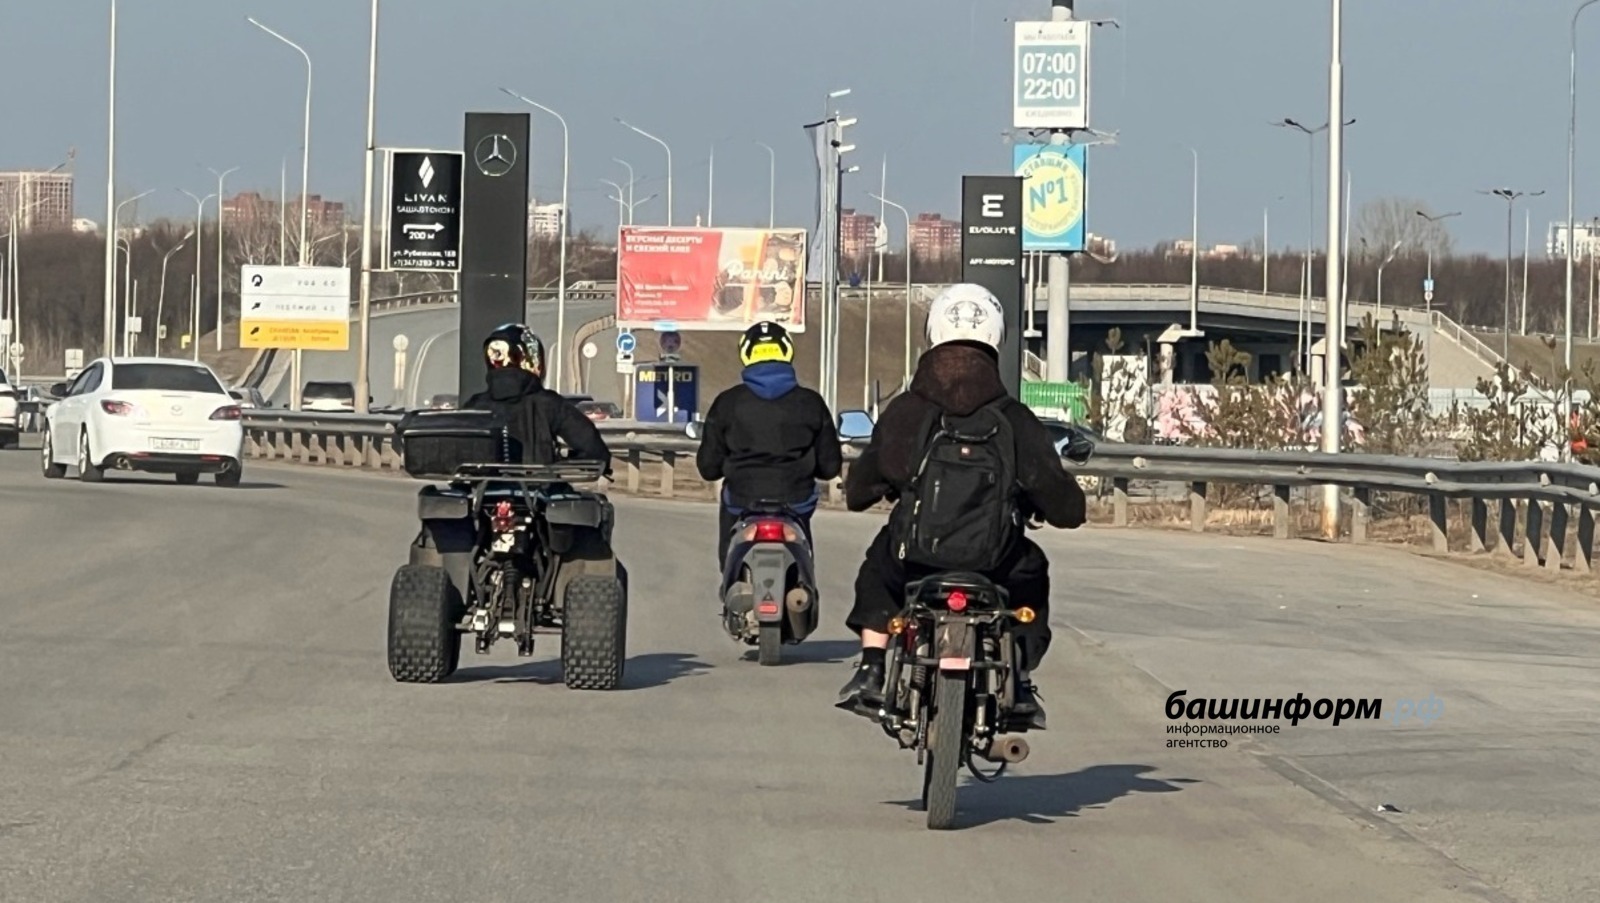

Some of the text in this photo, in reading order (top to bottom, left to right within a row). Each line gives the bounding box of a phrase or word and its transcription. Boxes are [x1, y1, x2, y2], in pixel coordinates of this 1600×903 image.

[1023, 52, 1076, 74] 07:00
[1024, 78, 1076, 100] 22:00
[404, 193, 447, 203] LIVAN
[408, 231, 426, 240] 200
[969, 226, 1016, 235] EVOLUTE
[727, 259, 789, 281] Panini
[639, 370, 692, 383] METRO
